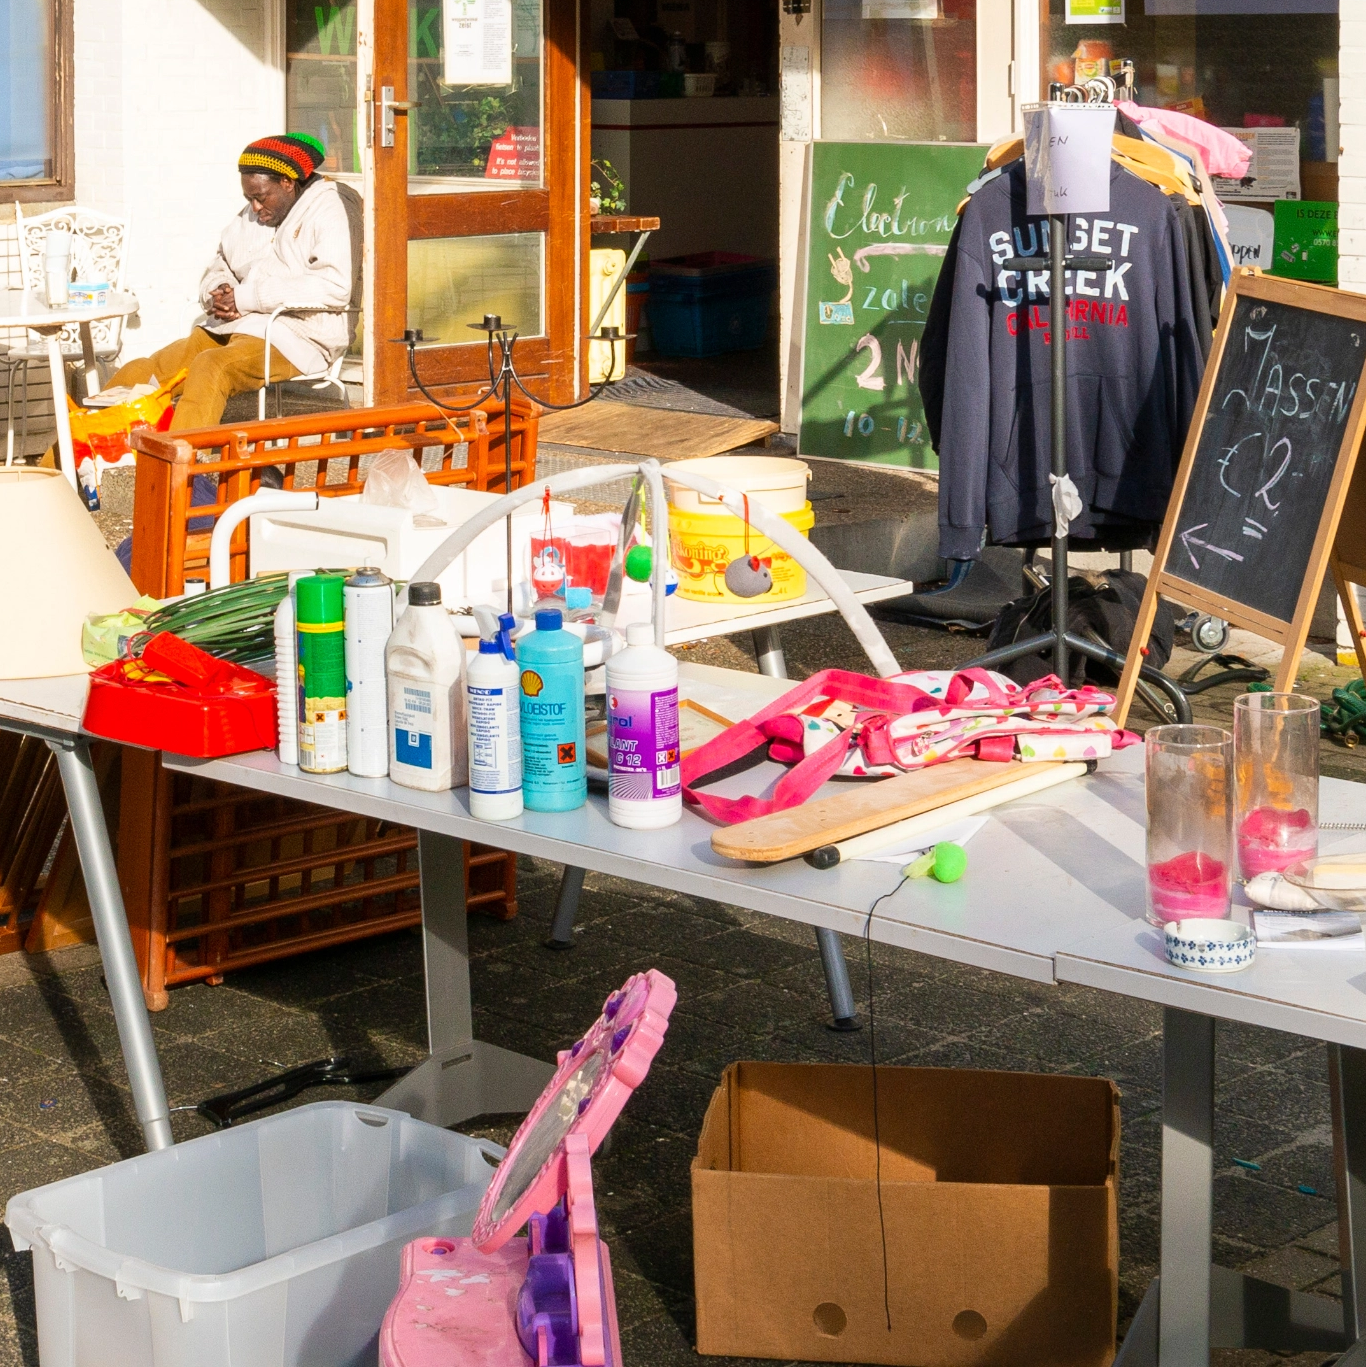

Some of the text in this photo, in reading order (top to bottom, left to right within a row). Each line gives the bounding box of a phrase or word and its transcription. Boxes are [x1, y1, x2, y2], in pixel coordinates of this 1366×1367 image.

[495, 157, 505, 165] It's
[499, 168, 516, 176] place
[1296, 209, 1331, 219] IS DEZE
[855, 332, 887, 391] 2
[843, 410, 875, 438] 10
[609, 736, 639, 753] LANT
[616, 752, 642, 766] G 12
